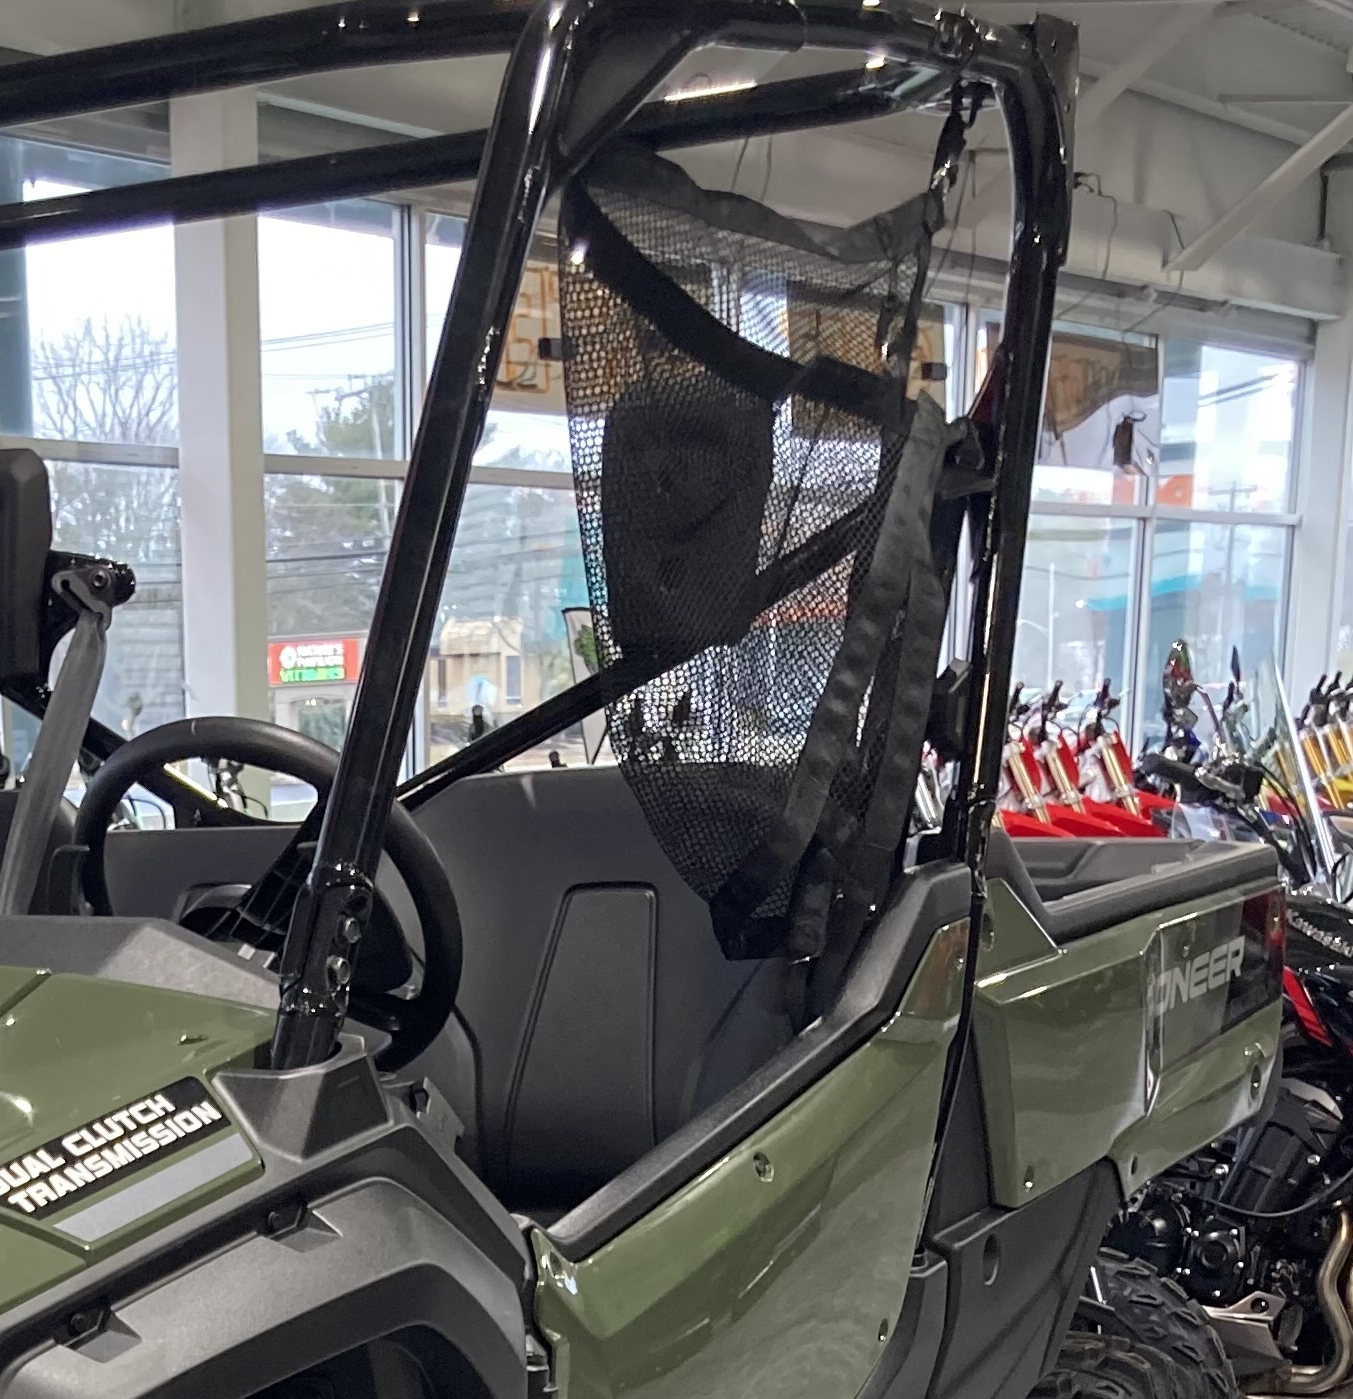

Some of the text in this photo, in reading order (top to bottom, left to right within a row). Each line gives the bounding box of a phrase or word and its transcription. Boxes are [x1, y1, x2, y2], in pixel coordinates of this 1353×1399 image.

[1147, 935, 1246, 1017] ONEER
[7, 1101, 223, 1214] TRANSMISSION
[61, 1094, 176, 1157] CLUTCH
